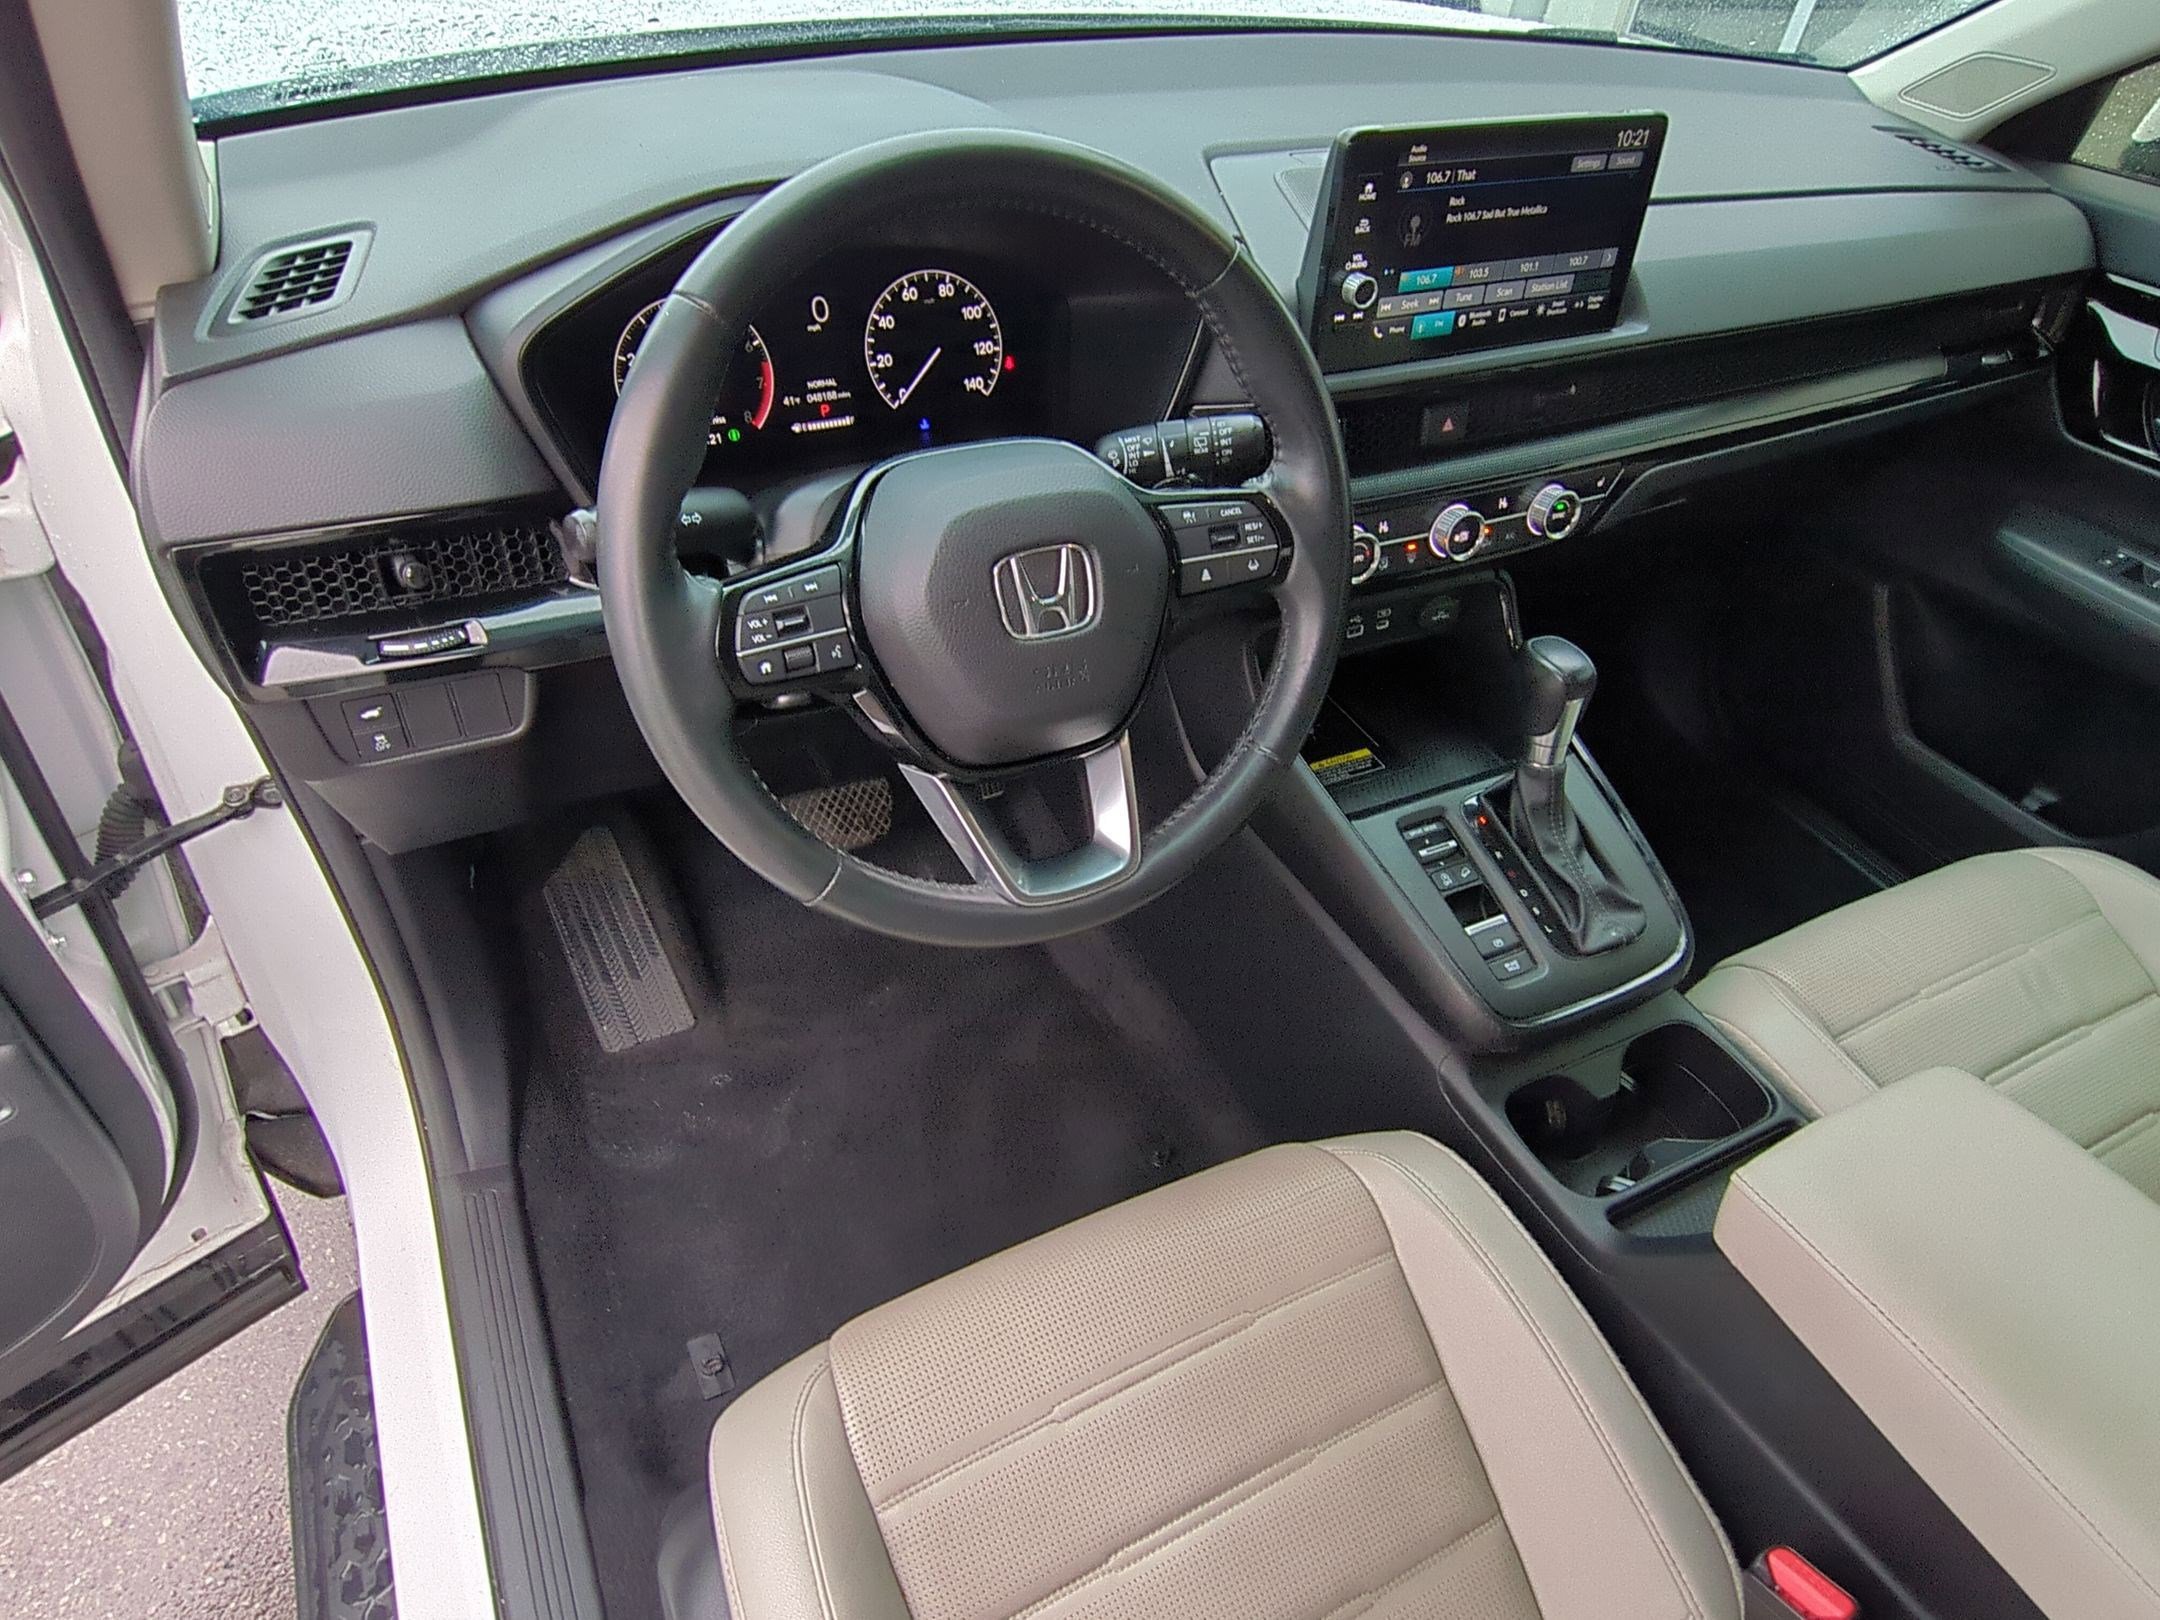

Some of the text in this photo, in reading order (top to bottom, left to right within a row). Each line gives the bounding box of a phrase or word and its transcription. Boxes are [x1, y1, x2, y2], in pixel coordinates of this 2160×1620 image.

[1617, 129, 1650, 148] 10:21
[1426, 169, 1477, 184] 106.7 That
[1449, 196, 1466, 207] Rock
[1446, 212, 1462, 223] Rock
[1416, 256, 1588, 286] 106.7 103.5 101.1 100.7
[902, 286, 918, 302] 60
[938, 283, 955, 297] 80
[1401, 280, 1568, 310] Seek Tune Scan Station List
[811, 295, 829, 323] 0
[961, 306, 982, 320] 100
[878, 315, 895, 330] 40
[745, 341, 753, 353] 6
[973, 341, 994, 356] 120
[876, 354, 893, 368] 20
[756, 377, 763, 389] 7
[806, 378, 838, 390] NORMAL
[963, 376, 984, 392] 140
[744, 410, 752, 423] 8
[820, 404, 830, 418] P
[1220, 507, 1243, 517] CANCEL
